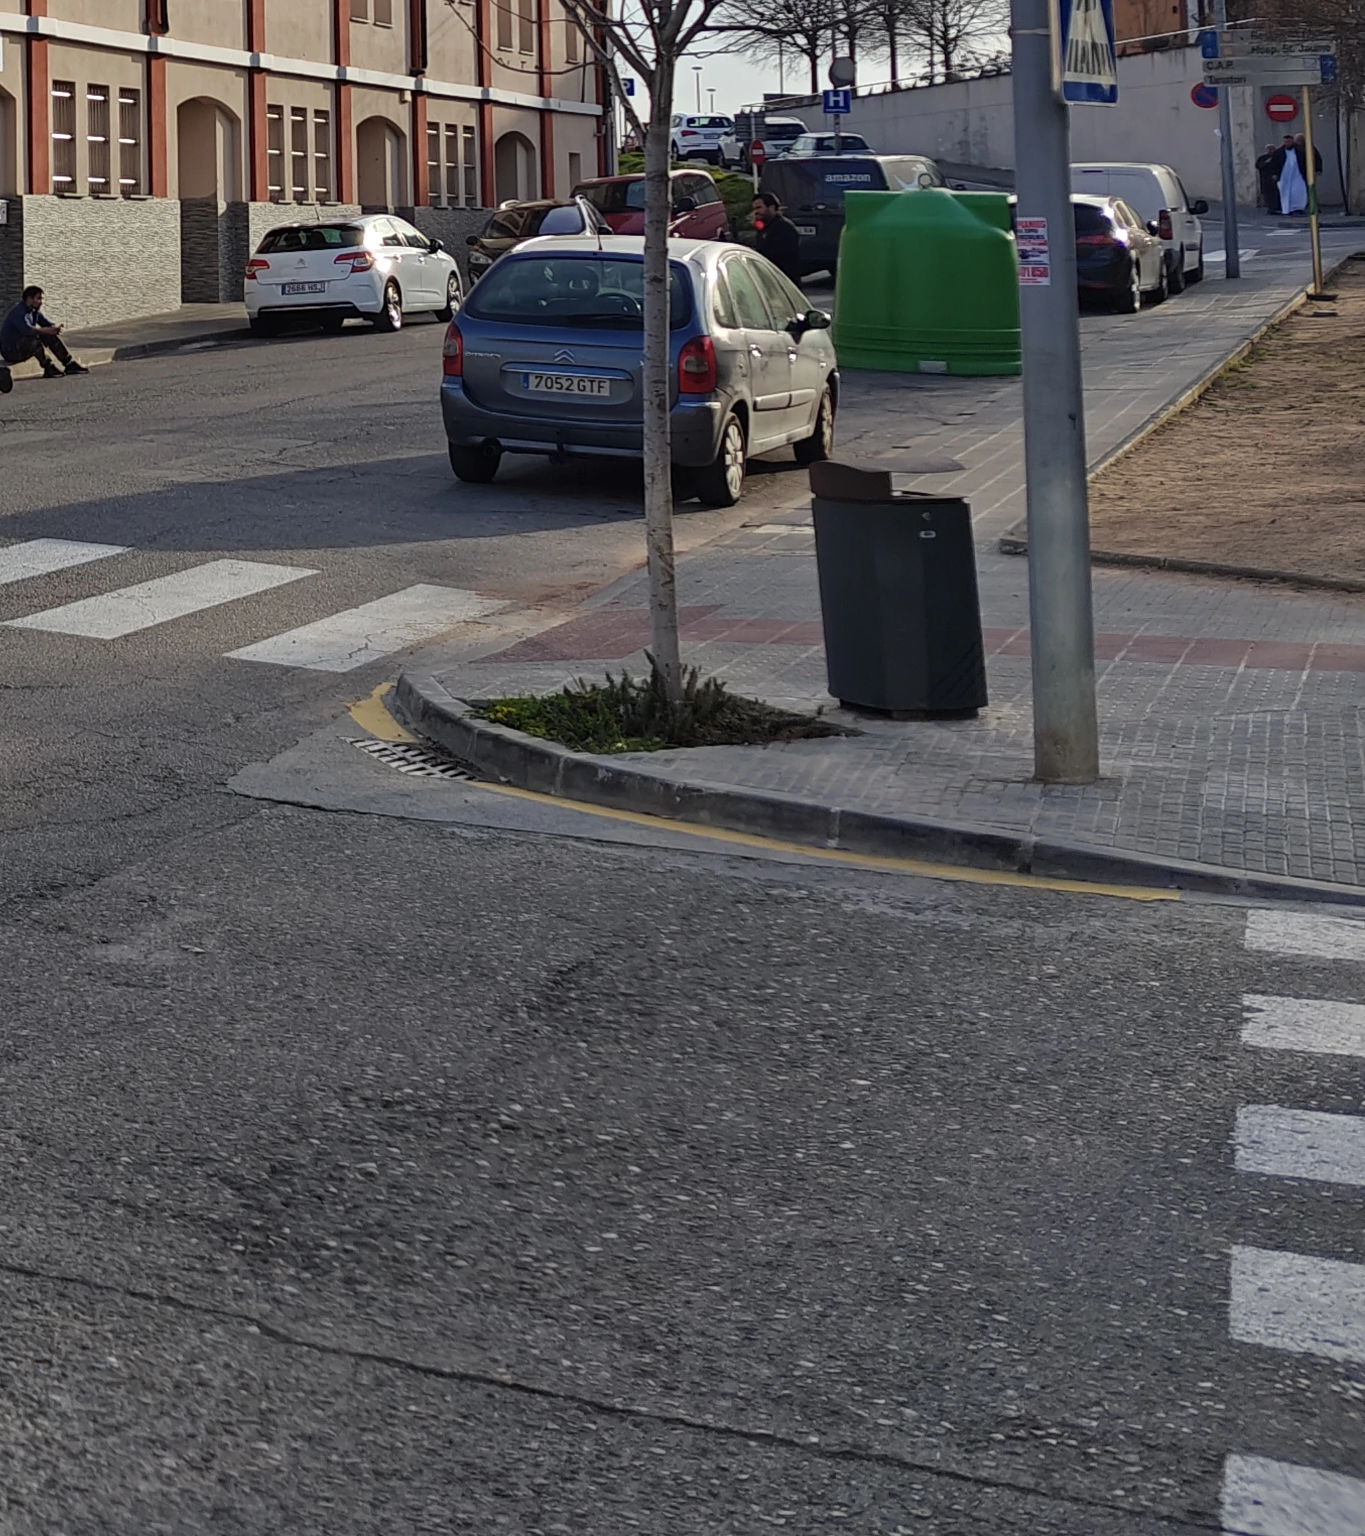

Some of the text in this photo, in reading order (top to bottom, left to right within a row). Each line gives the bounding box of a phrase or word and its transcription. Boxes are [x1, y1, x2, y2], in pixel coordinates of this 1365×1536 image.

[829, 91, 845, 107] H
[825, 172, 871, 183] amazon
[533, 375, 607, 394] 7052 GTF
